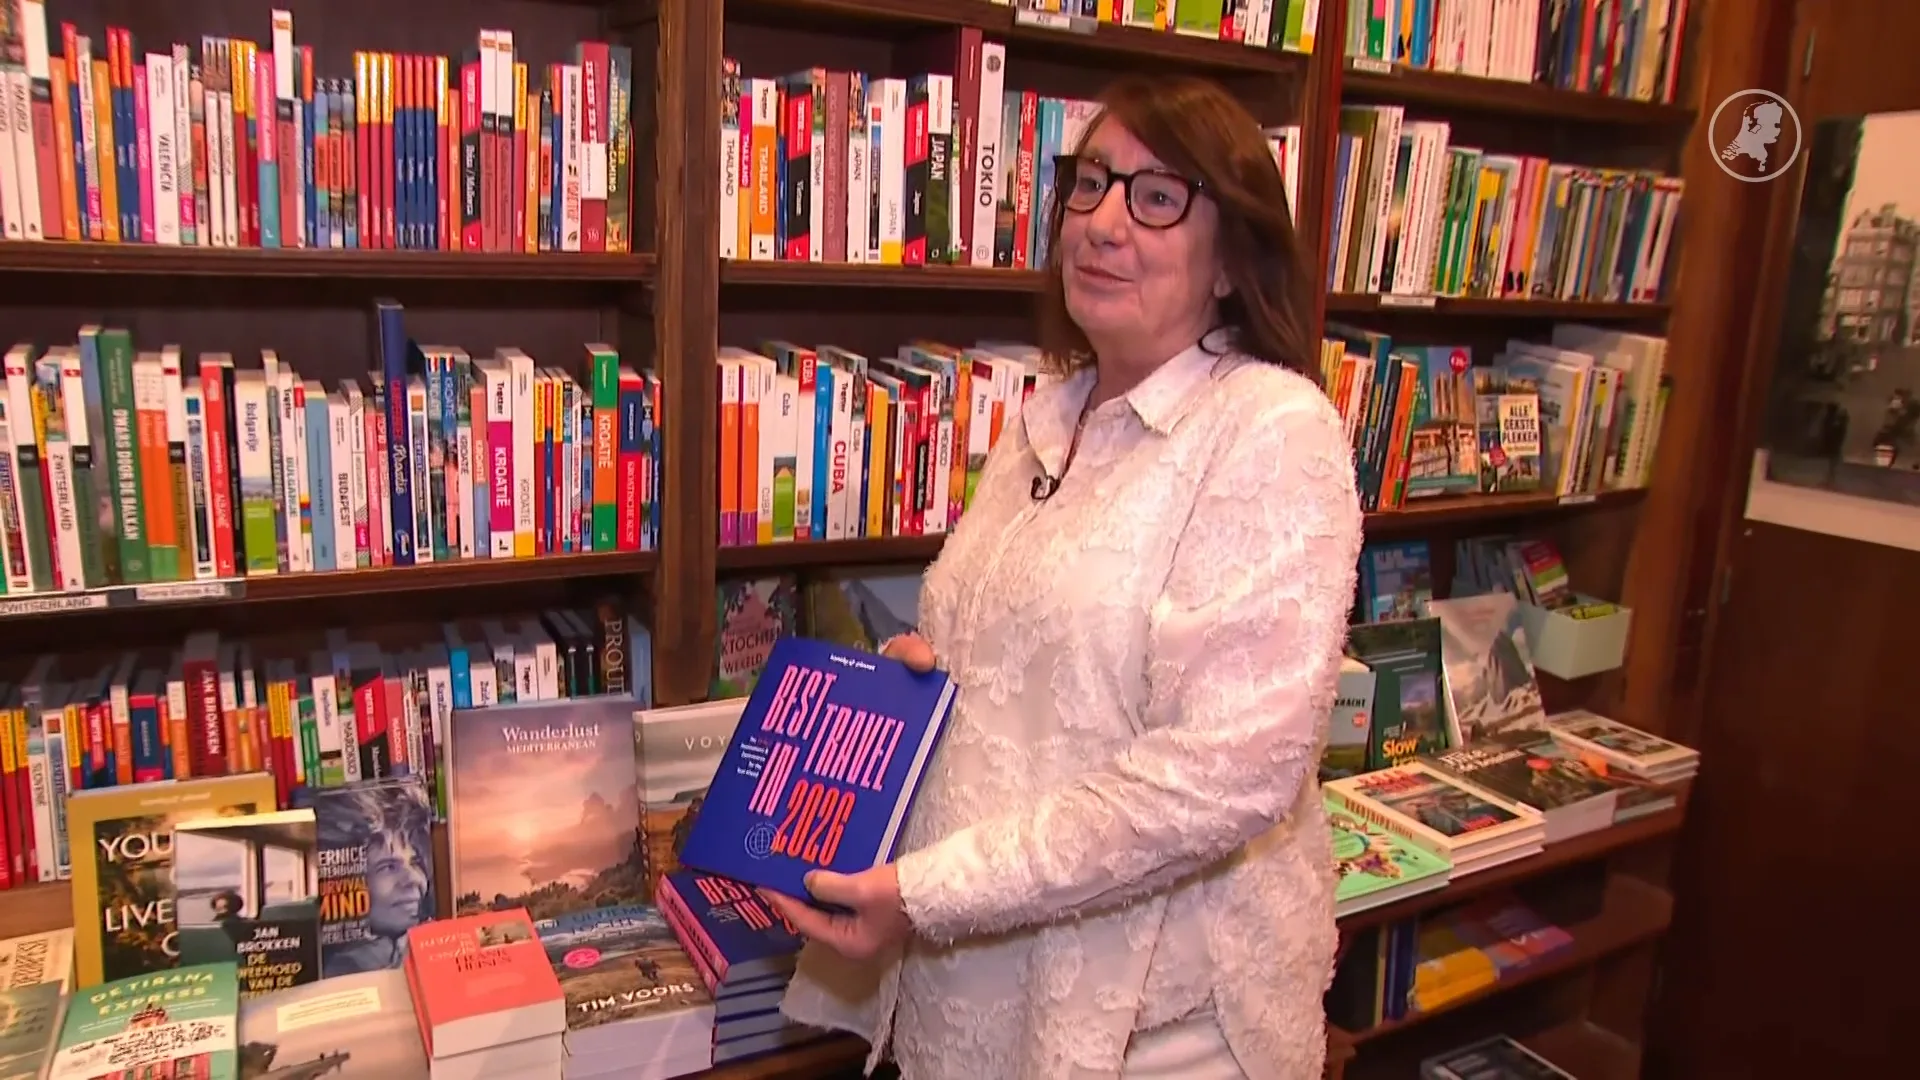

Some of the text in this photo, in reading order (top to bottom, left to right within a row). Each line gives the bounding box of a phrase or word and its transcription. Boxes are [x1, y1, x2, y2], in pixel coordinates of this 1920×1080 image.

[158, 133, 174, 193] VALENCIA
[725, 140, 736, 196] THAILAND
[741, 134, 750, 186] THAILAND
[853, 147, 863, 182] JAPAN
[929, 136, 945, 181] JAPAN
[980, 142, 995, 207] TOKIO
[758, 146, 769, 215] THAILAND
[802, 358, 814, 385] CUBA
[496, 382, 507, 415] Trotter
[782, 392, 792, 418] Cuba
[245, 402, 259, 452] Bulgarije
[598, 414, 613, 469] KROATIË
[286, 456, 298, 518] BULGARIJE
[494, 447, 511, 508] KROATIË
[832, 440, 847, 495] CUBA
[52, 453, 73, 531] ZWITSERLAND
[338, 473, 351, 527] BUDAPEST
[520, 478, 532, 526] KROATIË
[121, 497, 140, 541] BALKAN
[723, 653, 763, 675] WERELD
[202, 669, 219, 755] JAN BROKKEN
[761, 664, 838, 741] BEST
[343, 721, 357, 775] MAROKKO
[502, 722, 600, 742] Wanderlust
[506, 739, 597, 754] MEDITERRANEAN
[684, 734, 727, 751] VOY
[802, 703, 905, 792] TRAVEL
[1382, 738, 1418, 758] Slow
[748, 741, 800, 817] IN
[770, 778, 856, 867] 2026
[98, 830, 176, 863] YOU
[318, 846, 368, 867] ERNICE
[694, 876, 753, 906] BEST
[105, 899, 175, 933] LIVE
[253, 926, 279, 941] JAN
[733, 899, 773, 931] IN
[236, 935, 301, 954] BROKKEN
[247, 953, 267, 967] DE
[90, 971, 214, 1005] DE TIRANA
[98, 986, 207, 1016] EXPRESS
[248, 974, 294, 991] VAN DE
[577, 982, 696, 1013] TIM VOORS
